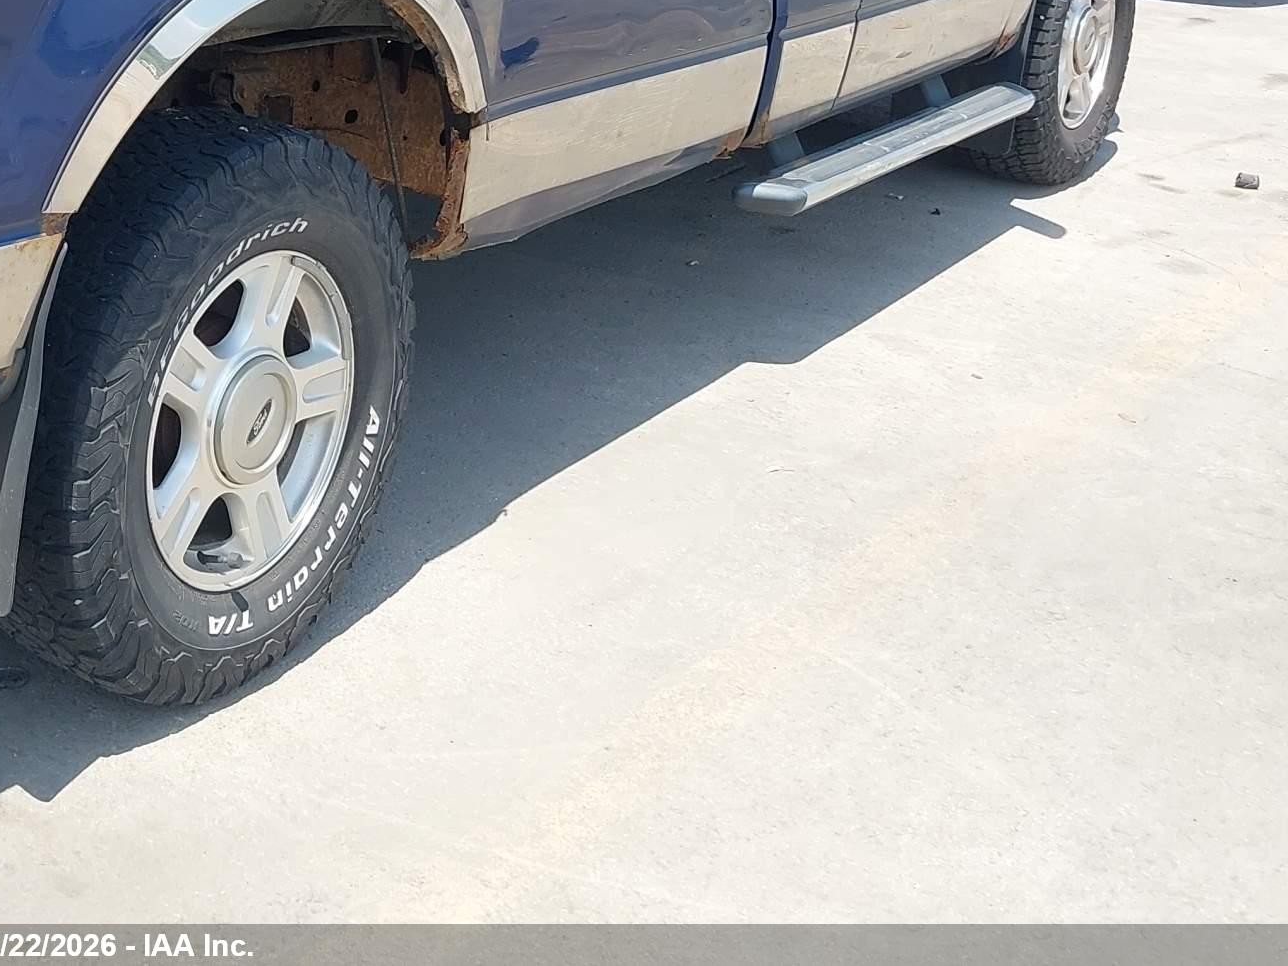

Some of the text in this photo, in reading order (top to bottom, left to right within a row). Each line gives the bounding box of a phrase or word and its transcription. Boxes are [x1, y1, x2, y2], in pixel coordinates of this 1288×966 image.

[147, 216, 309, 408] BFGoodrich
[208, 404, 381, 636] All-Terrain T/A
